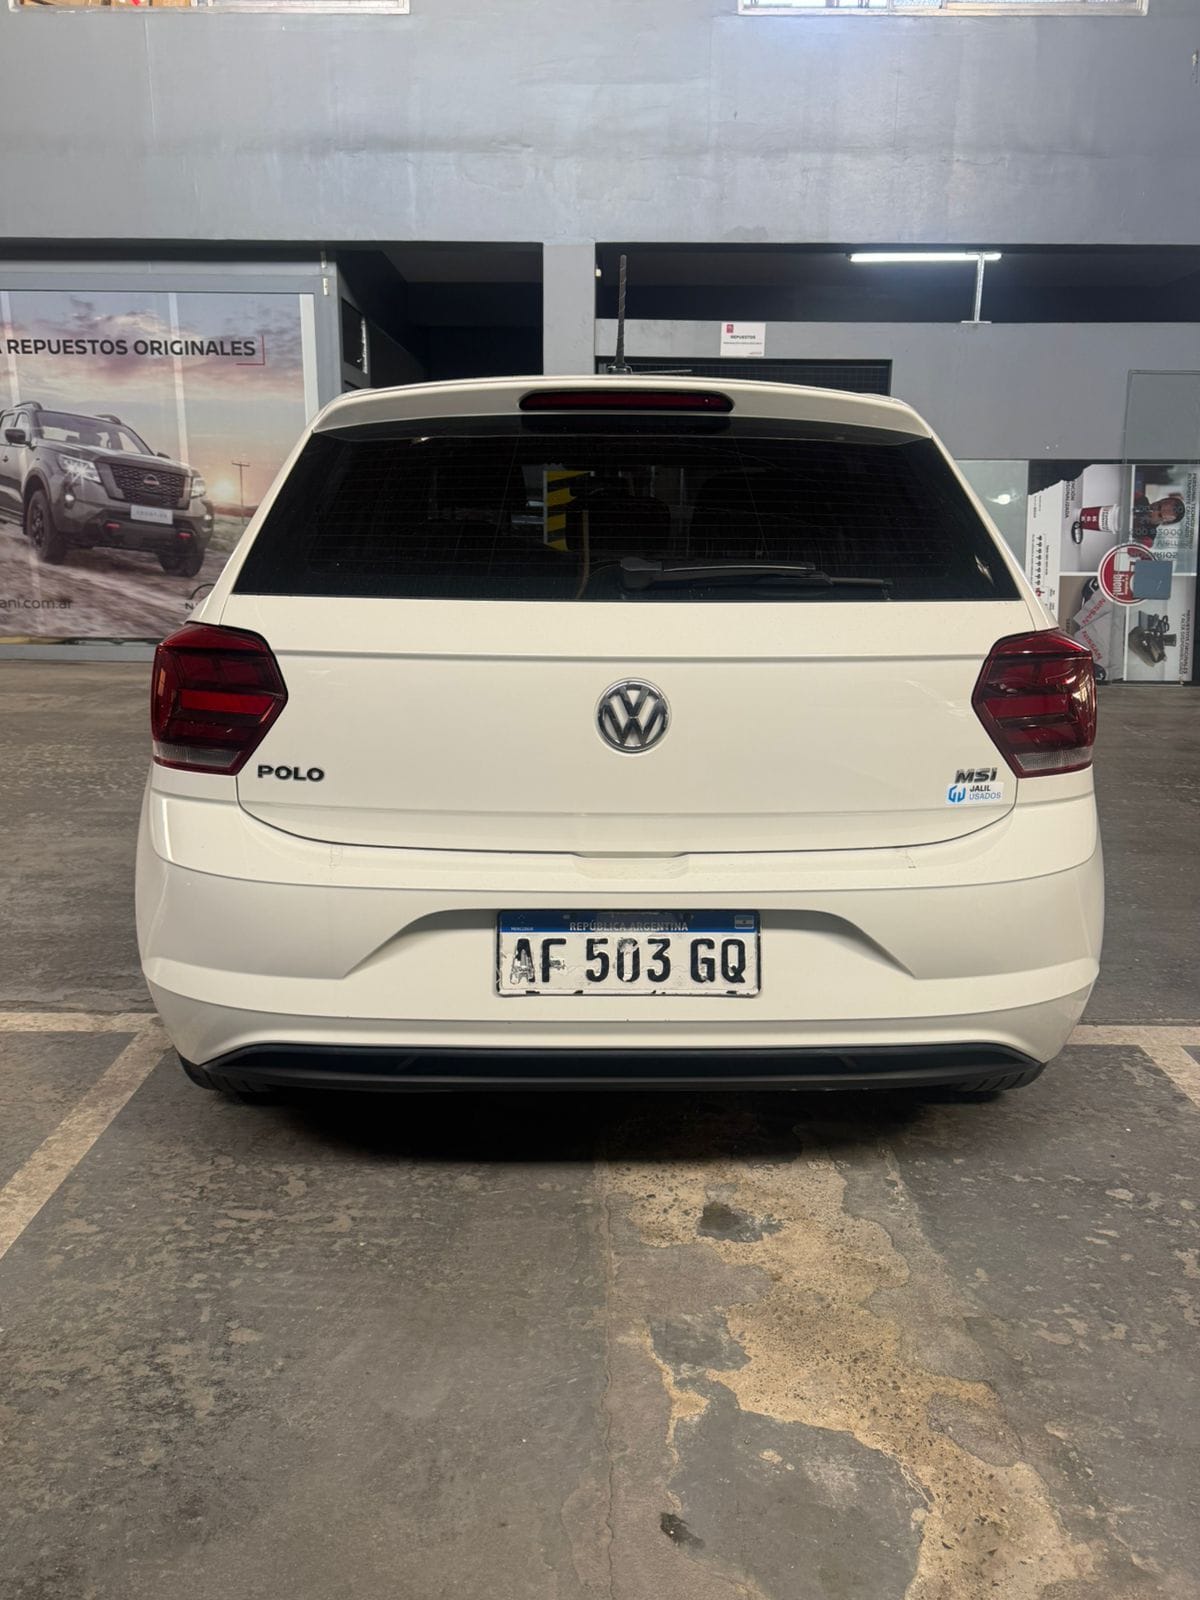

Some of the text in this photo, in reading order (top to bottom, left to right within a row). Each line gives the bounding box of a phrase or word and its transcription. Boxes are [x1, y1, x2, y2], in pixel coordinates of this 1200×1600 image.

[7, 339, 127, 355] REPUESTOS
[133, 340, 256, 356] ORIGINALES
[257, 764, 325, 782] POLO
[955, 768, 998, 783] MSI
[969, 792, 1002, 800] USADOS
[629, 921, 689, 932] ARGENTINA
[510, 937, 747, 985] AF 503 GQ
